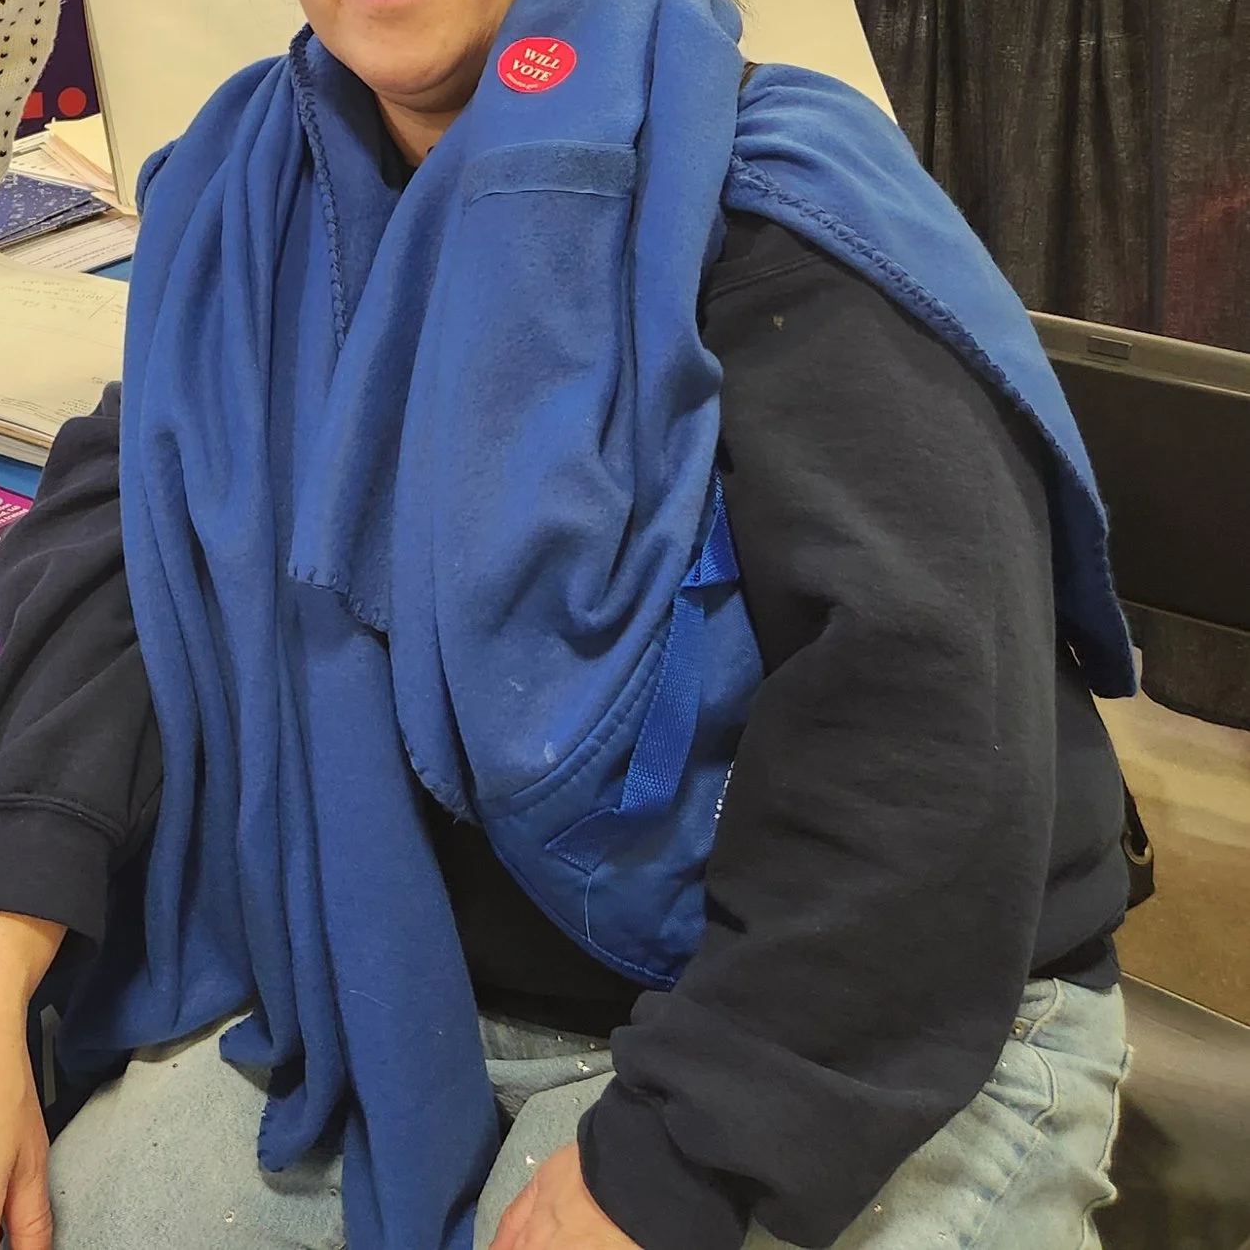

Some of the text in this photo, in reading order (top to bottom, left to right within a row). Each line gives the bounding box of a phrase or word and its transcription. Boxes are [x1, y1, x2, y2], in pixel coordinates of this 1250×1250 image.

[524, 48, 561, 69] WILL
[548, 43, 558, 53] I
[512, 59, 552, 82] VOTE
